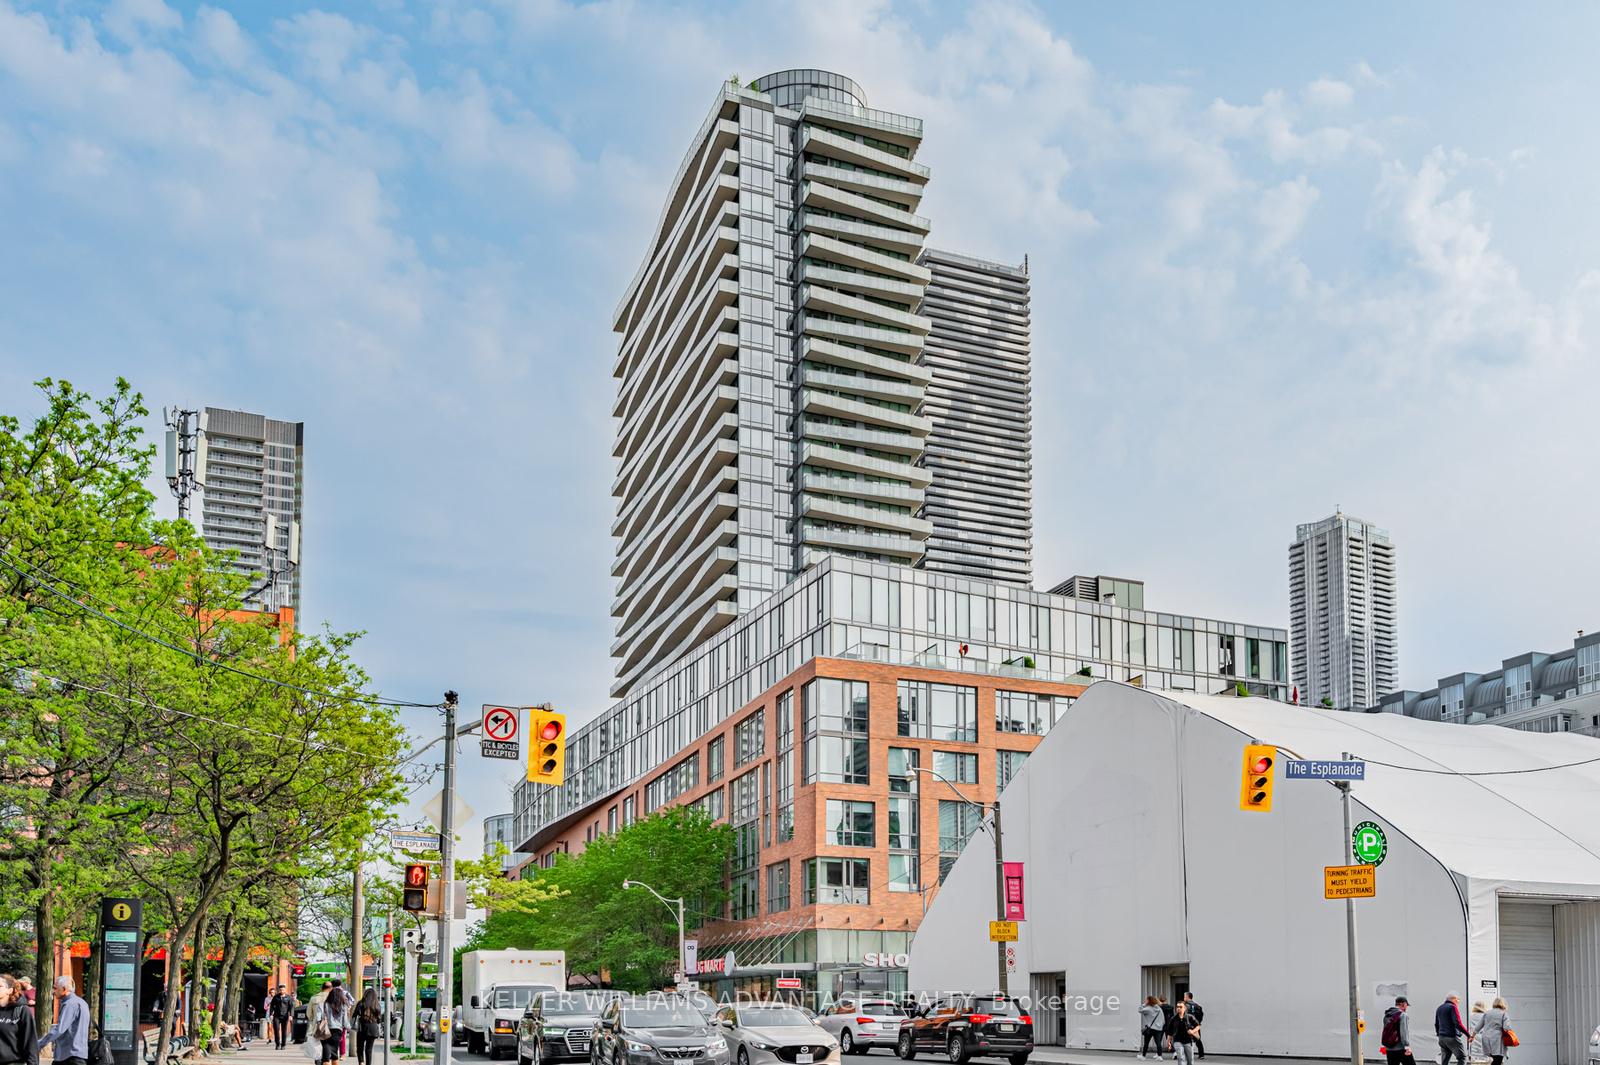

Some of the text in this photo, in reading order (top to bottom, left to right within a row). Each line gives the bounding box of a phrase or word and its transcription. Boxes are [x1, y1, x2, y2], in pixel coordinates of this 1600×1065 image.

[484, 749, 517, 758] EXCEPTED
[1288, 761, 1362, 778] The Esplanade
[405, 841, 438, 849] ESPLANADE
[1363, 832, 1377, 852] P
[1327, 868, 1372, 877] TURNING TRAFFIC
[1335, 887, 1372, 895] PEDESTRIANS
[863, 952, 909, 967] SHO
